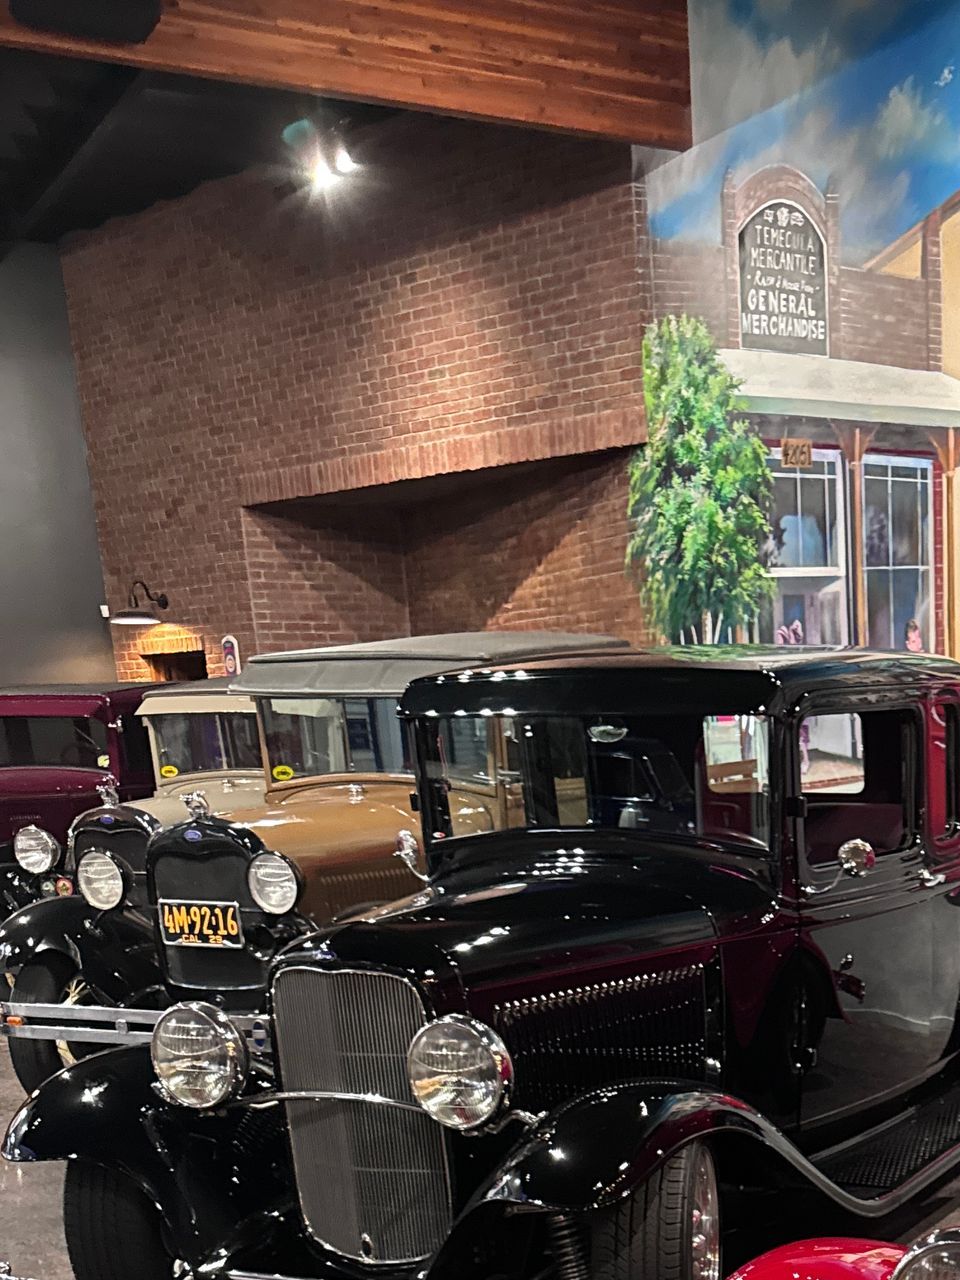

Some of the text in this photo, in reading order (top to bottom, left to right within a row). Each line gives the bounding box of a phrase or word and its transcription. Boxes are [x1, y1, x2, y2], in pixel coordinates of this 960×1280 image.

[755, 225, 815, 253] TEMECULA
[750, 247, 816, 276] MERCANTILE
[747, 289, 816, 318] GENERAL
[742, 313, 825, 340] MERCHANDISE
[181, 934, 202, 943] CAL
